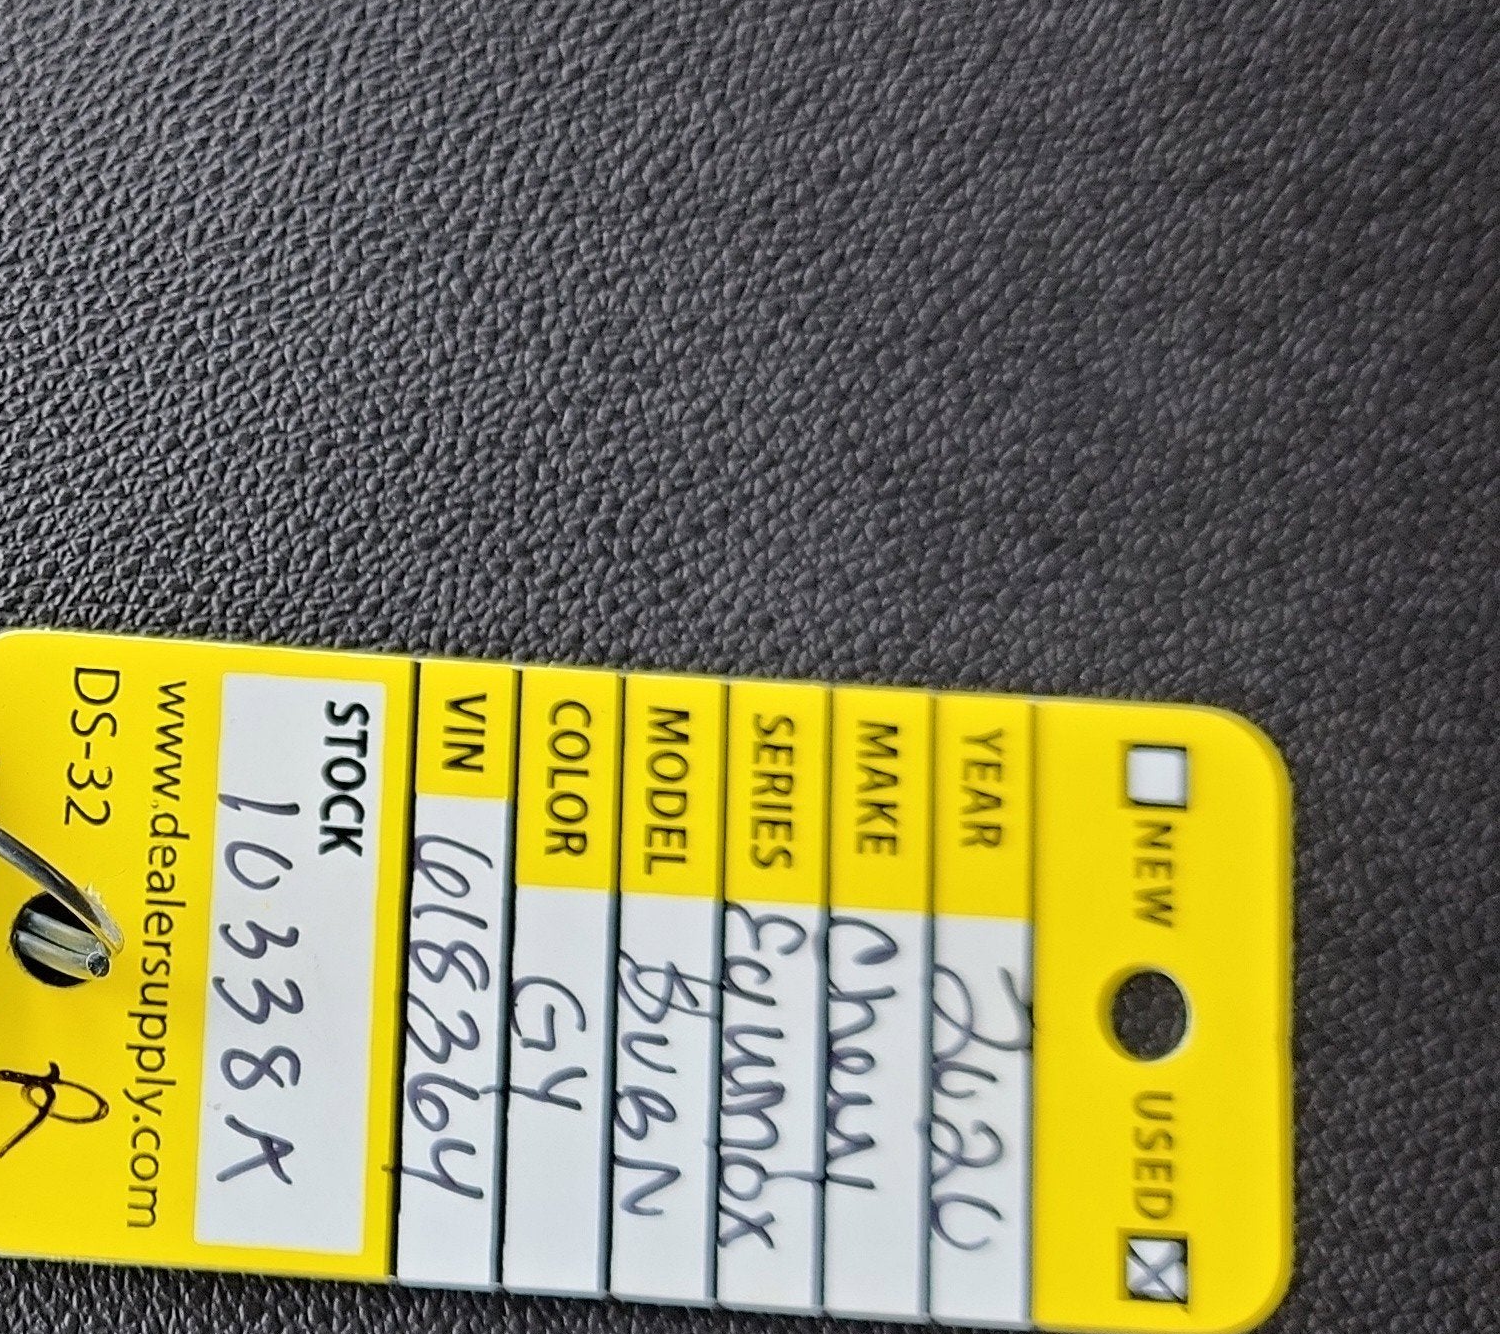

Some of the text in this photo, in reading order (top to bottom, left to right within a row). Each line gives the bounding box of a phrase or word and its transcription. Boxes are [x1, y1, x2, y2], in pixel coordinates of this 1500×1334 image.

[64, 666, 120, 827] DS-32
[318, 700, 370, 857] STOCK
[441, 692, 489, 774] VIN
[544, 700, 592, 858] COLOR
[643, 706, 690, 876] MODEL
[749, 712, 795, 870] SERIES
[855, 718, 900, 857] MAKE
[959, 728, 1005, 850] YEAR
[1132, 819, 1177, 929] NEW
[125, 679, 190, 1229] www.dealersupply.com
[213, 792, 304, 1186] 10338A
[384, 834, 494, 1199] 618364
[930, 964, 1035, 1251] 2020
[1132, 1091, 1177, 1220] USED
